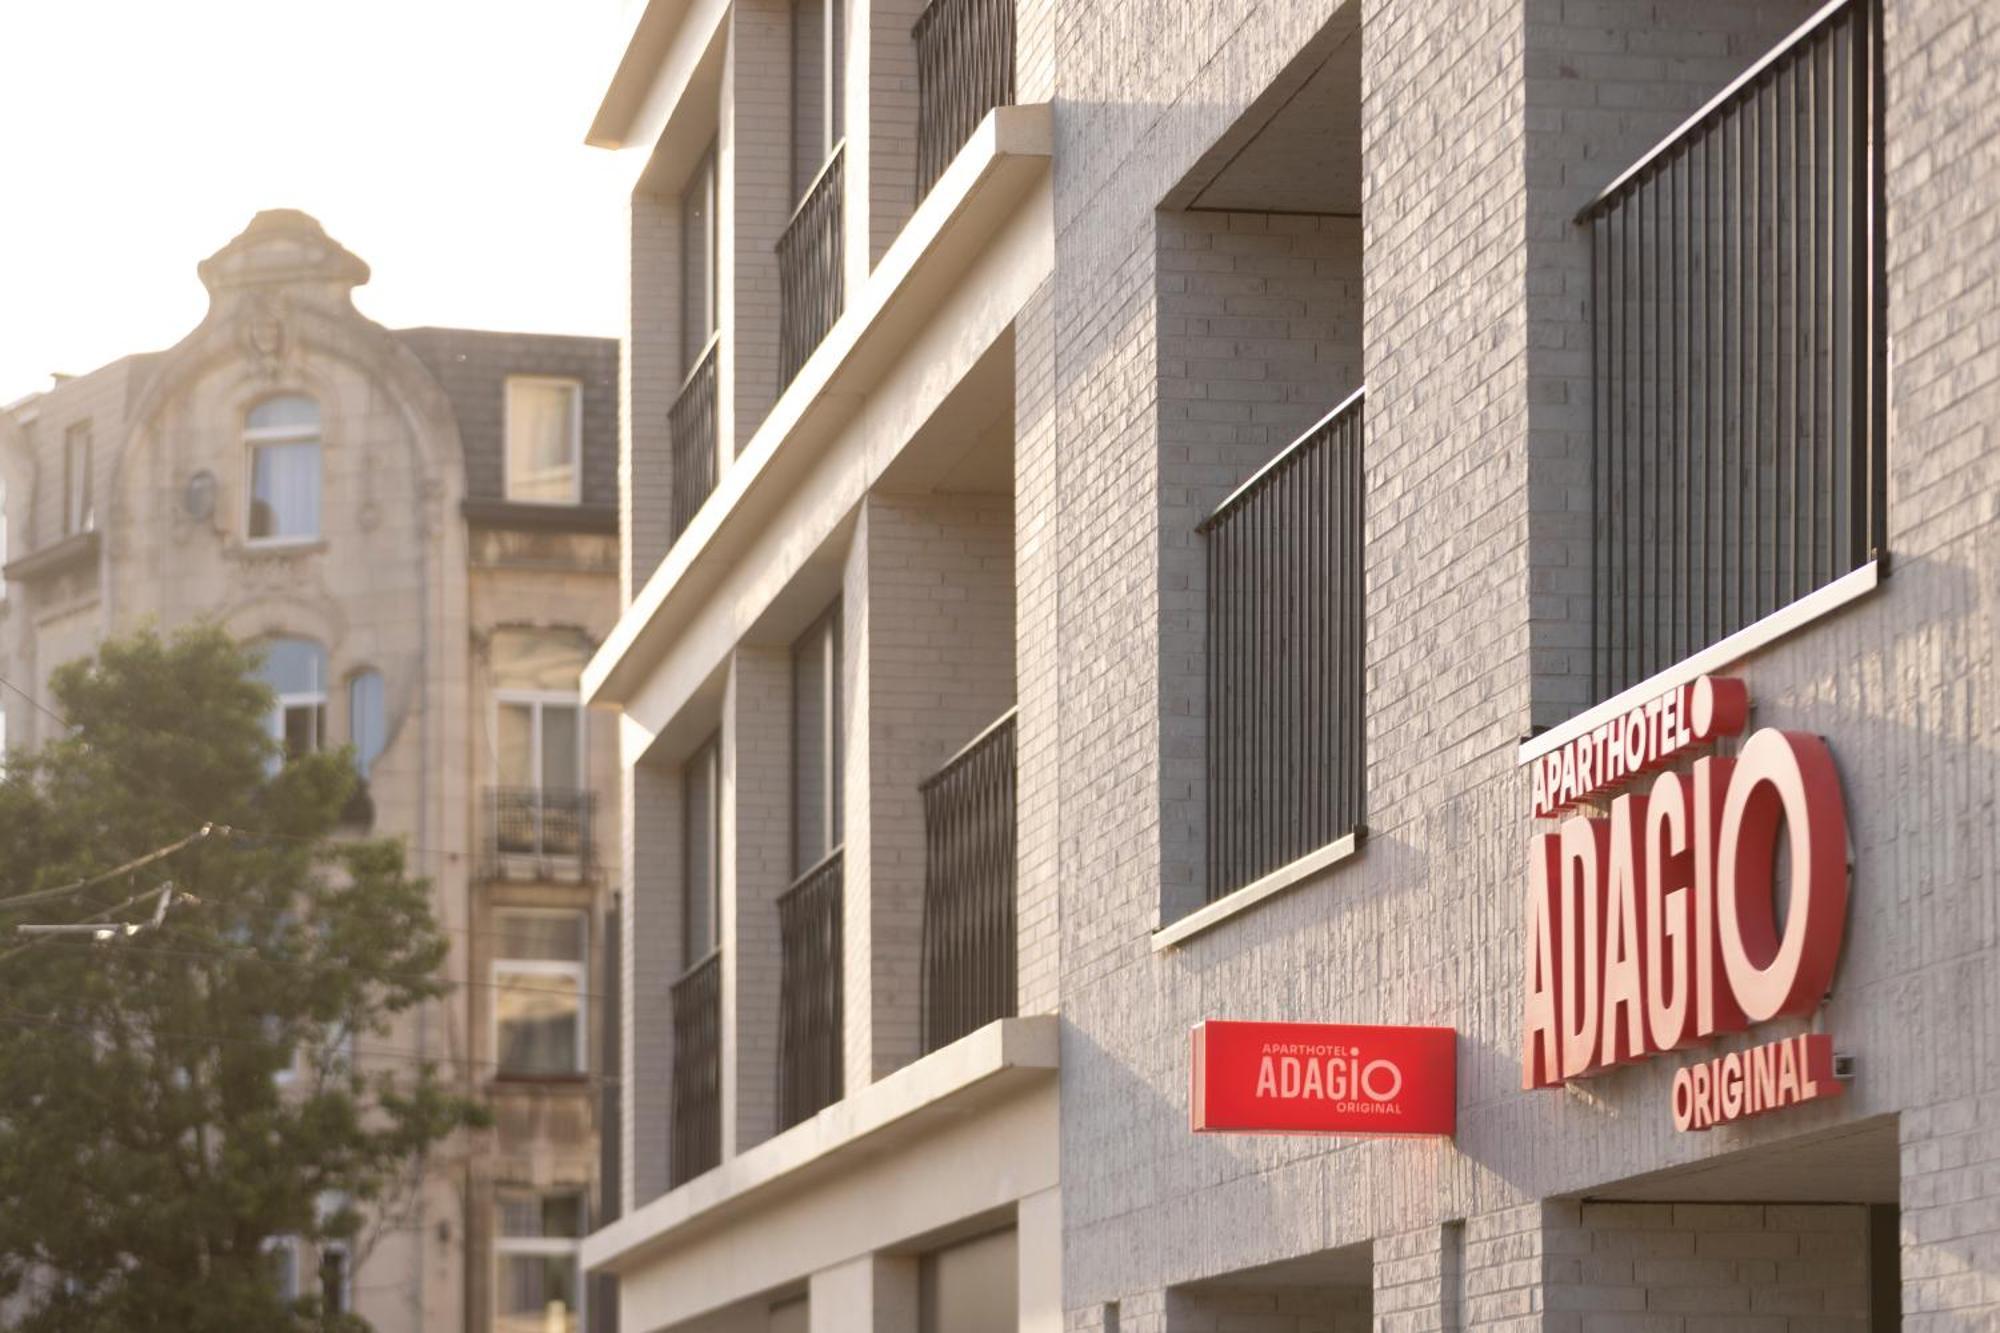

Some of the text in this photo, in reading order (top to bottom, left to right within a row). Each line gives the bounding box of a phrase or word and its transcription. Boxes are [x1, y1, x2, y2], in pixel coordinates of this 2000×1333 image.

[1532, 684, 1691, 818] APARTHOTEL
[1262, 1043, 1348, 1057] APARTHOTEL
[1336, 1102, 1402, 1114] ORIGINAL
[1672, 1033, 1817, 1132] ORIGINAL
